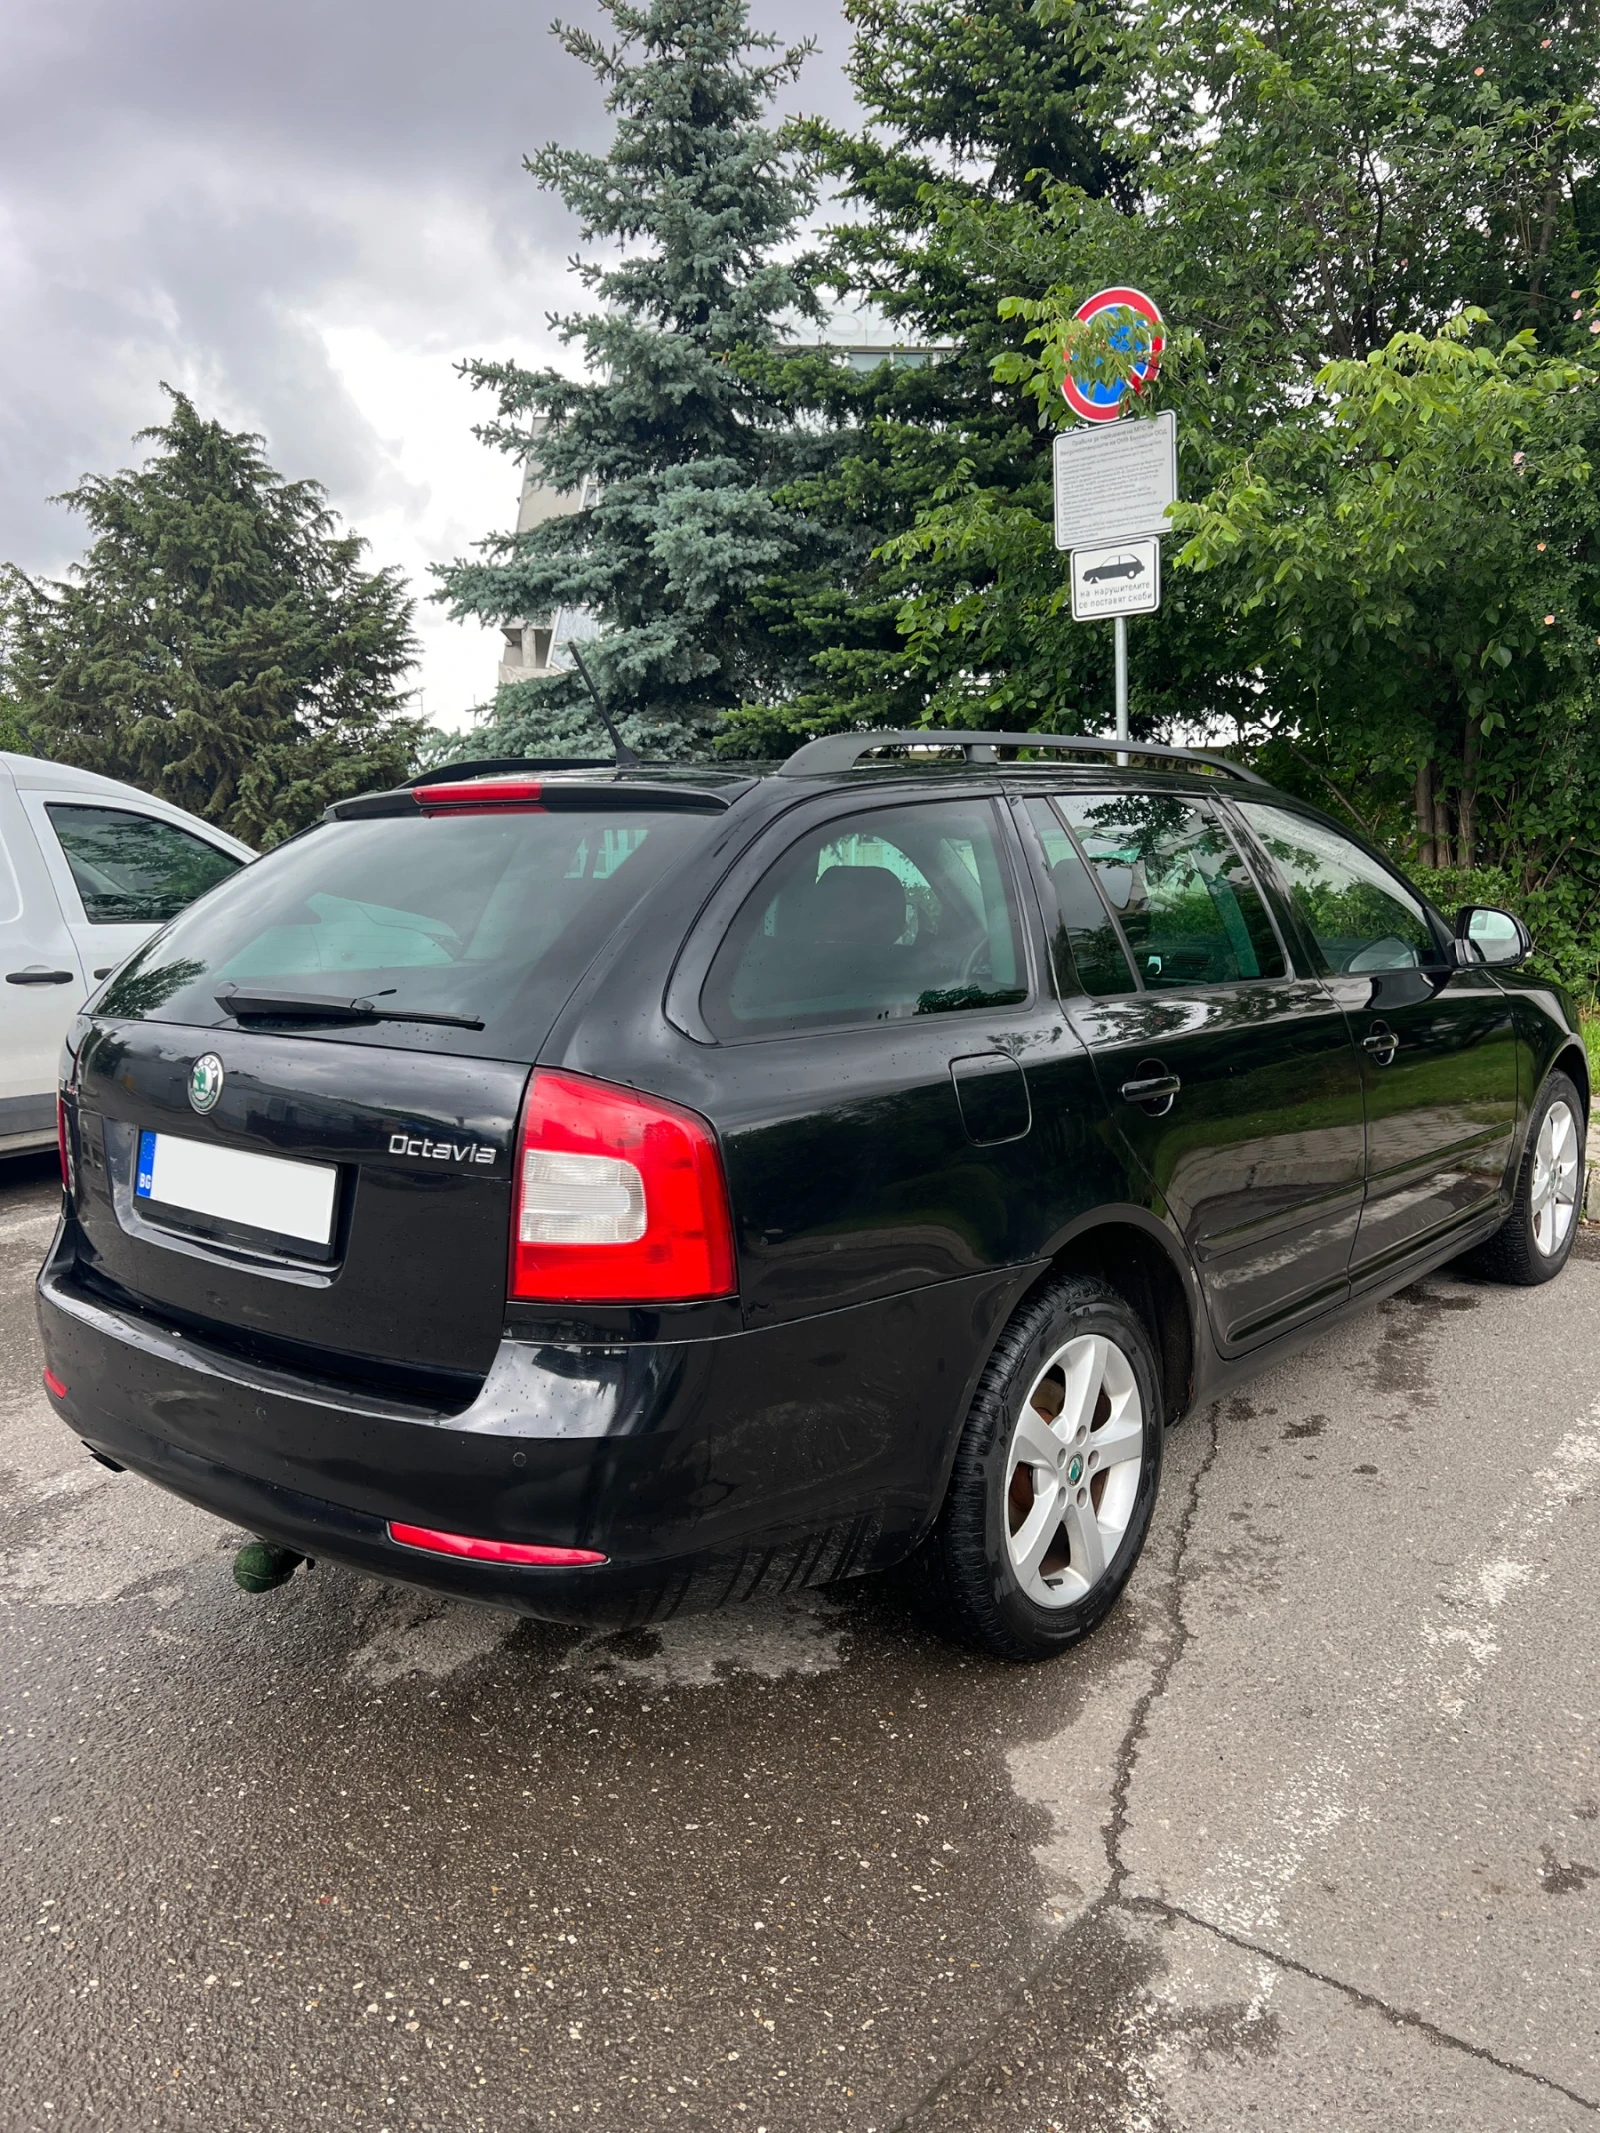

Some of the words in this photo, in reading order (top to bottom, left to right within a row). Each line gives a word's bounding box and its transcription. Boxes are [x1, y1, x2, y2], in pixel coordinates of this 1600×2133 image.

[1133, 425, 1146, 433] МПС
[1080, 590, 1090, 598] на
[1094, 581, 1150, 596] нарушителите
[1078, 601, 1088, 609] се
[1090, 596, 1126, 608] поставят
[1128, 591, 1152, 602] скоби
[388, 1134, 497, 1165] Octavia
[139, 1172, 152, 1190] BG
